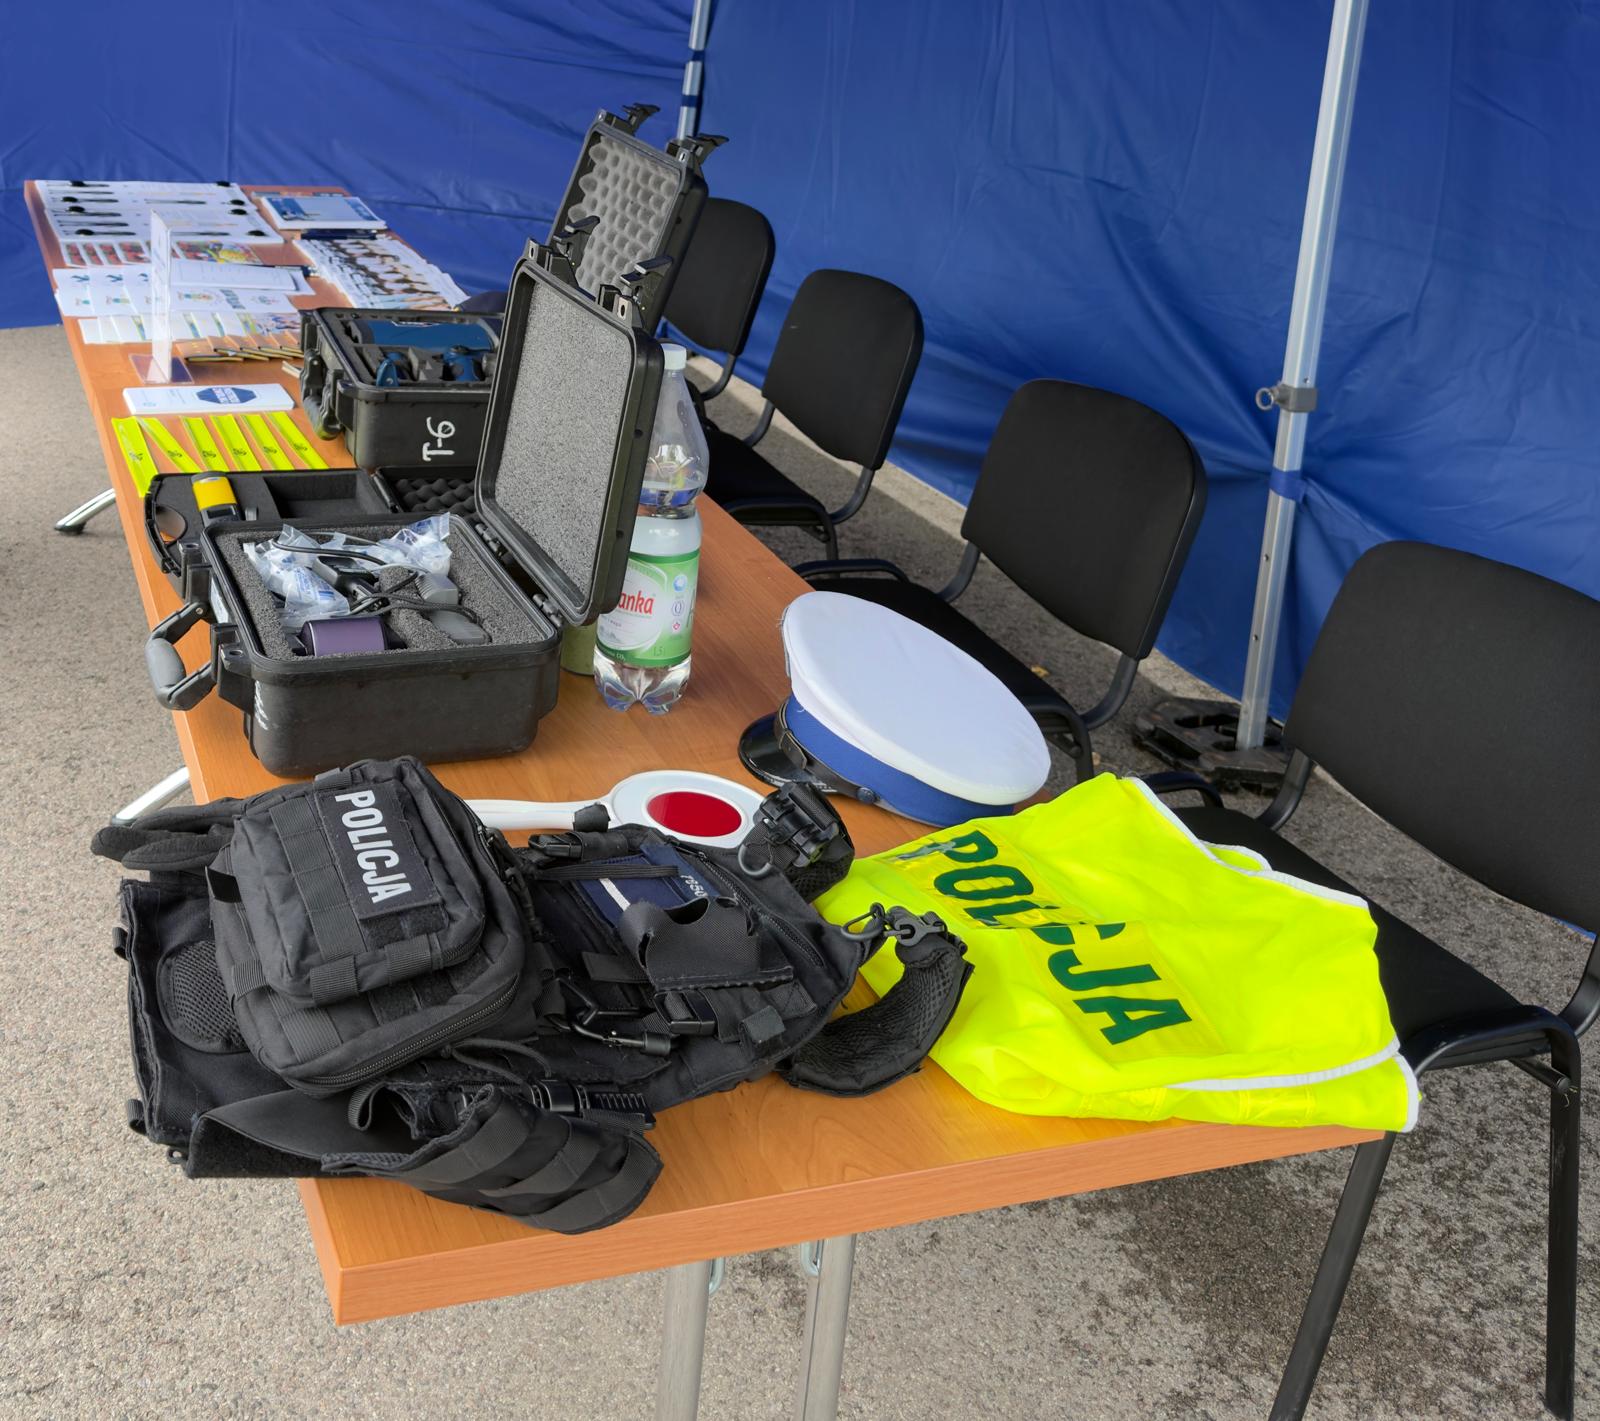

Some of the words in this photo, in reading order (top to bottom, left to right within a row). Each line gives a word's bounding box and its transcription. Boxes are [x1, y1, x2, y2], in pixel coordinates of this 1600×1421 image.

[422, 416, 456, 462] T-6
[618, 590, 655, 615] anka
[334, 789, 412, 904] POLICJA
[930, 829, 1193, 1046] POLJA
